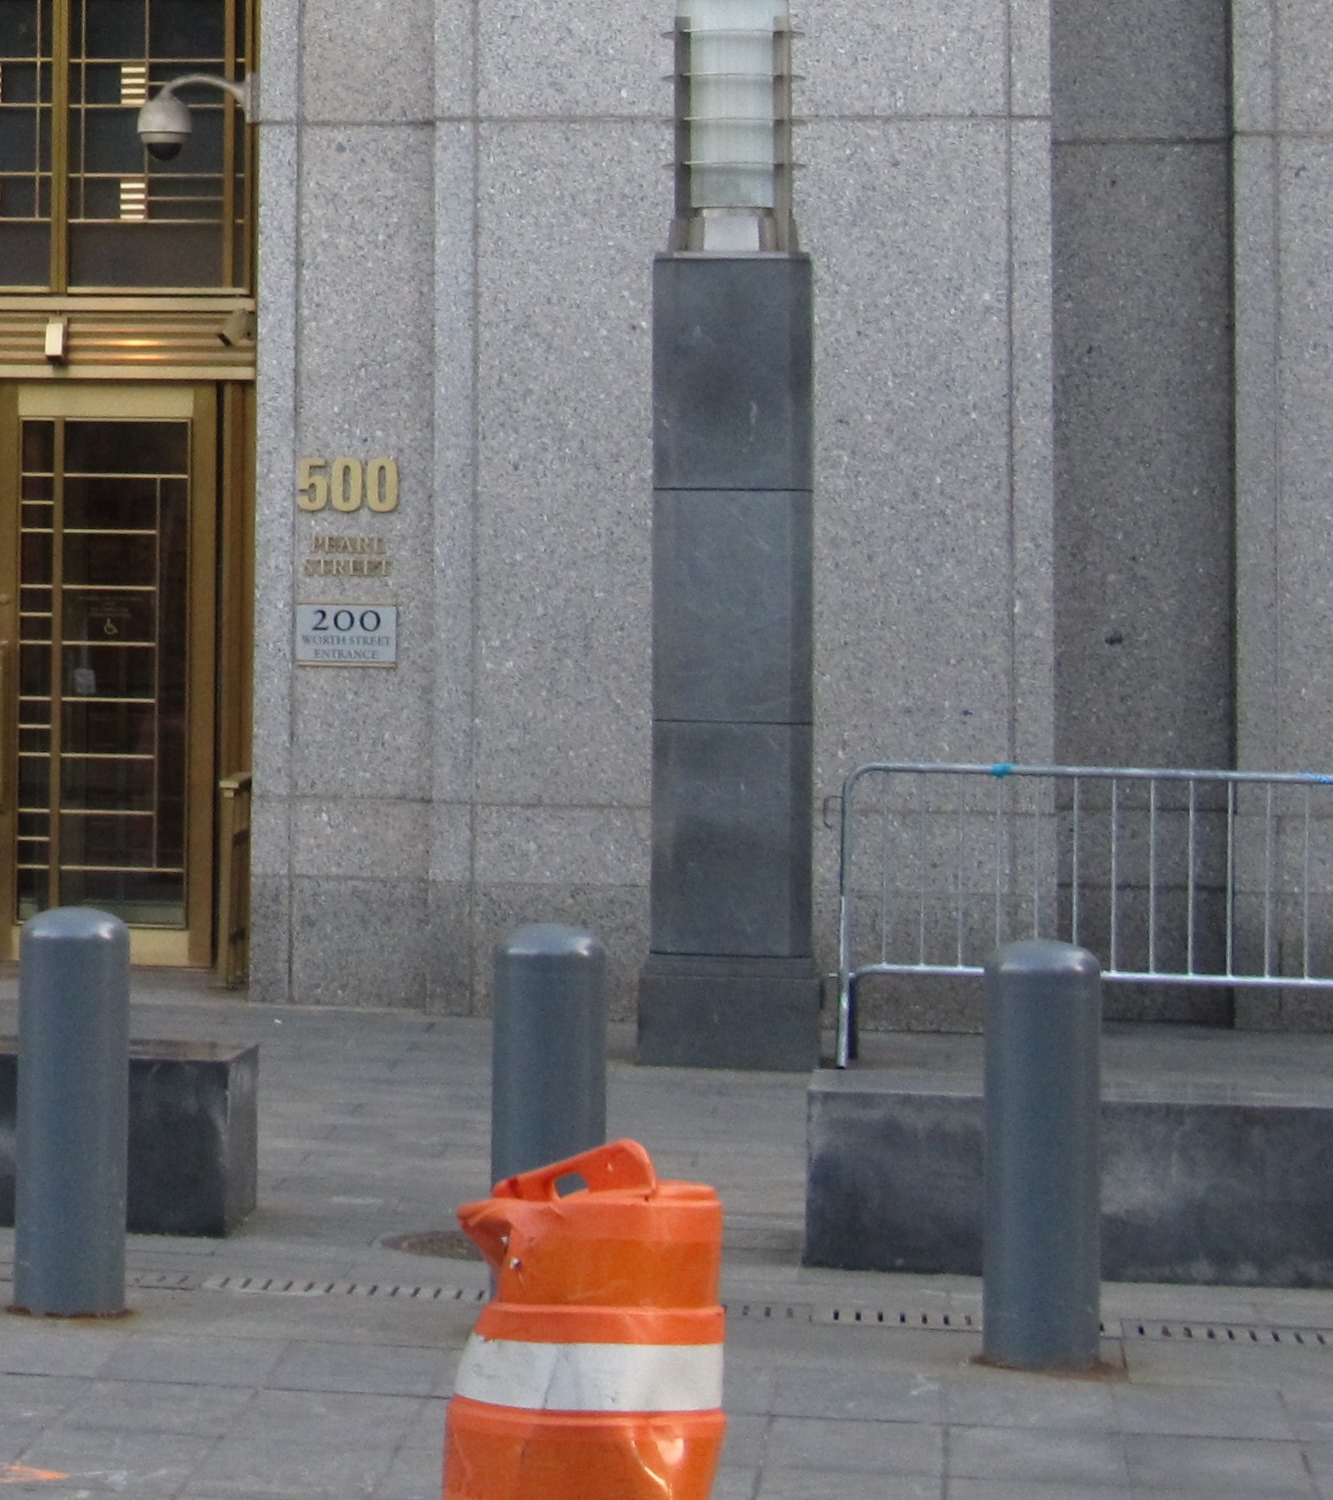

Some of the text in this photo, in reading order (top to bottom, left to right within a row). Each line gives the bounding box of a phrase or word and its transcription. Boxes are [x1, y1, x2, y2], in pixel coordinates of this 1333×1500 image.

[296, 456, 400, 514] 500
[311, 609, 381, 632] 200
[301, 635, 392, 646] WORTH STREET
[314, 649, 378, 660] ENTRANCE
